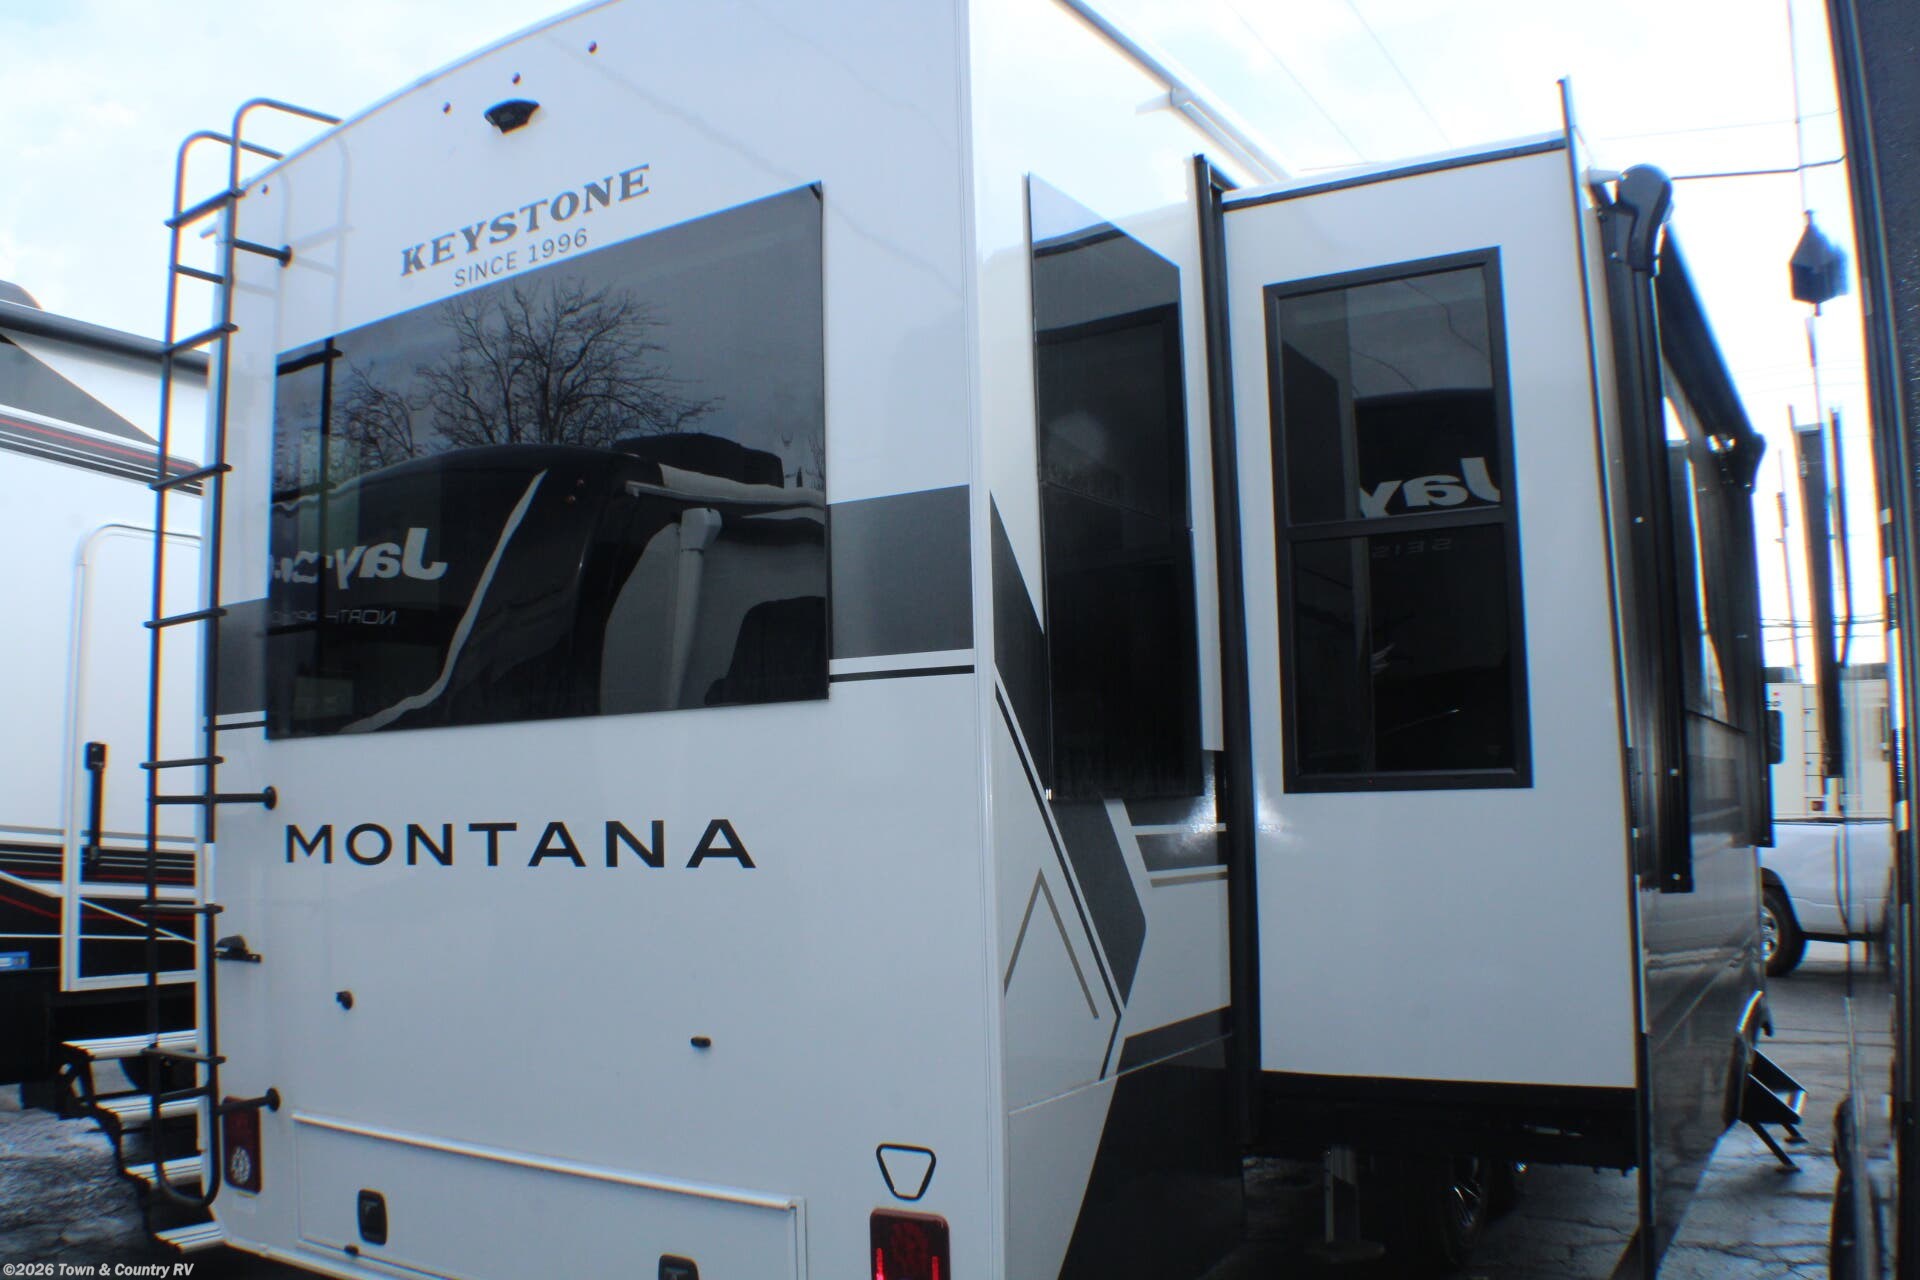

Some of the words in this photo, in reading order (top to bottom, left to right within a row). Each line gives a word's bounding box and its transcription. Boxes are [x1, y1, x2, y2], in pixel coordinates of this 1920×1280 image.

[400, 163, 650, 277] KEYSTONE
[453, 251, 518, 288] SINCE
[528, 227, 588, 264] 1996
[285, 818, 757, 869] MONTANA
